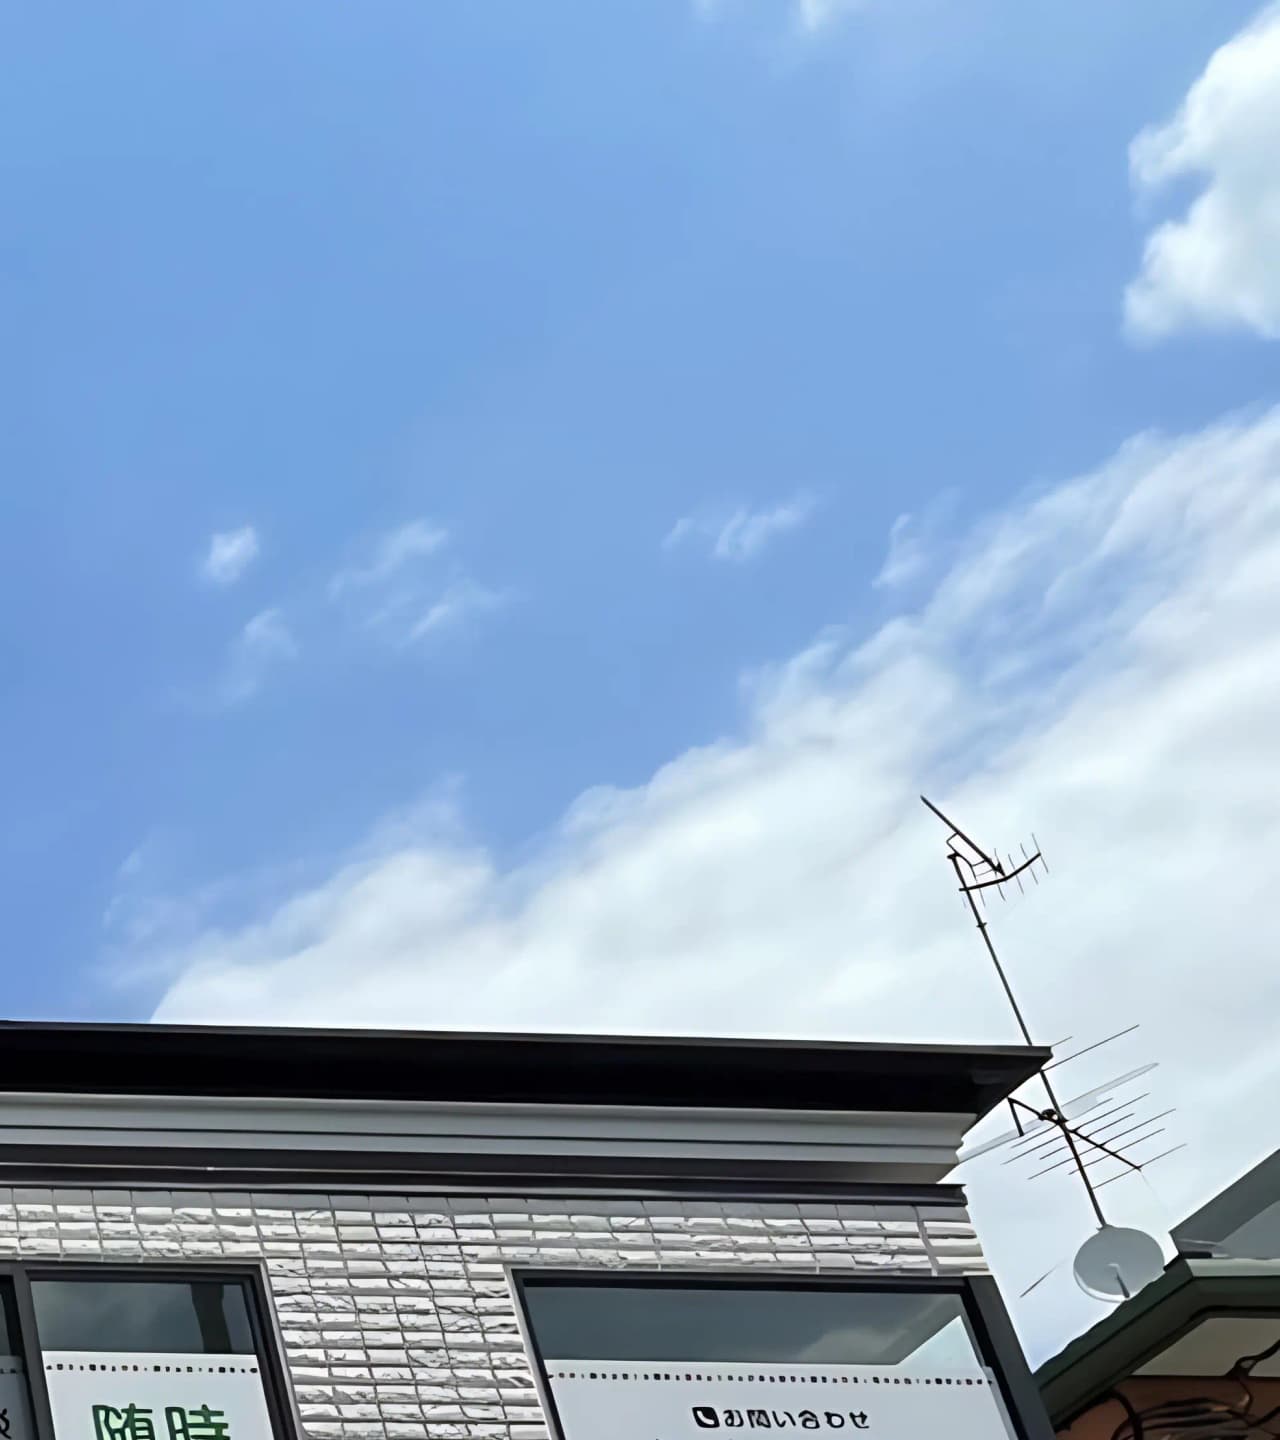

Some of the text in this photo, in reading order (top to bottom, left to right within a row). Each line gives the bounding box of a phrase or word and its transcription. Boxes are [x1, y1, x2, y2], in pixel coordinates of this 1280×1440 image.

[723, 1409, 870, 1429] お問い合わせ
